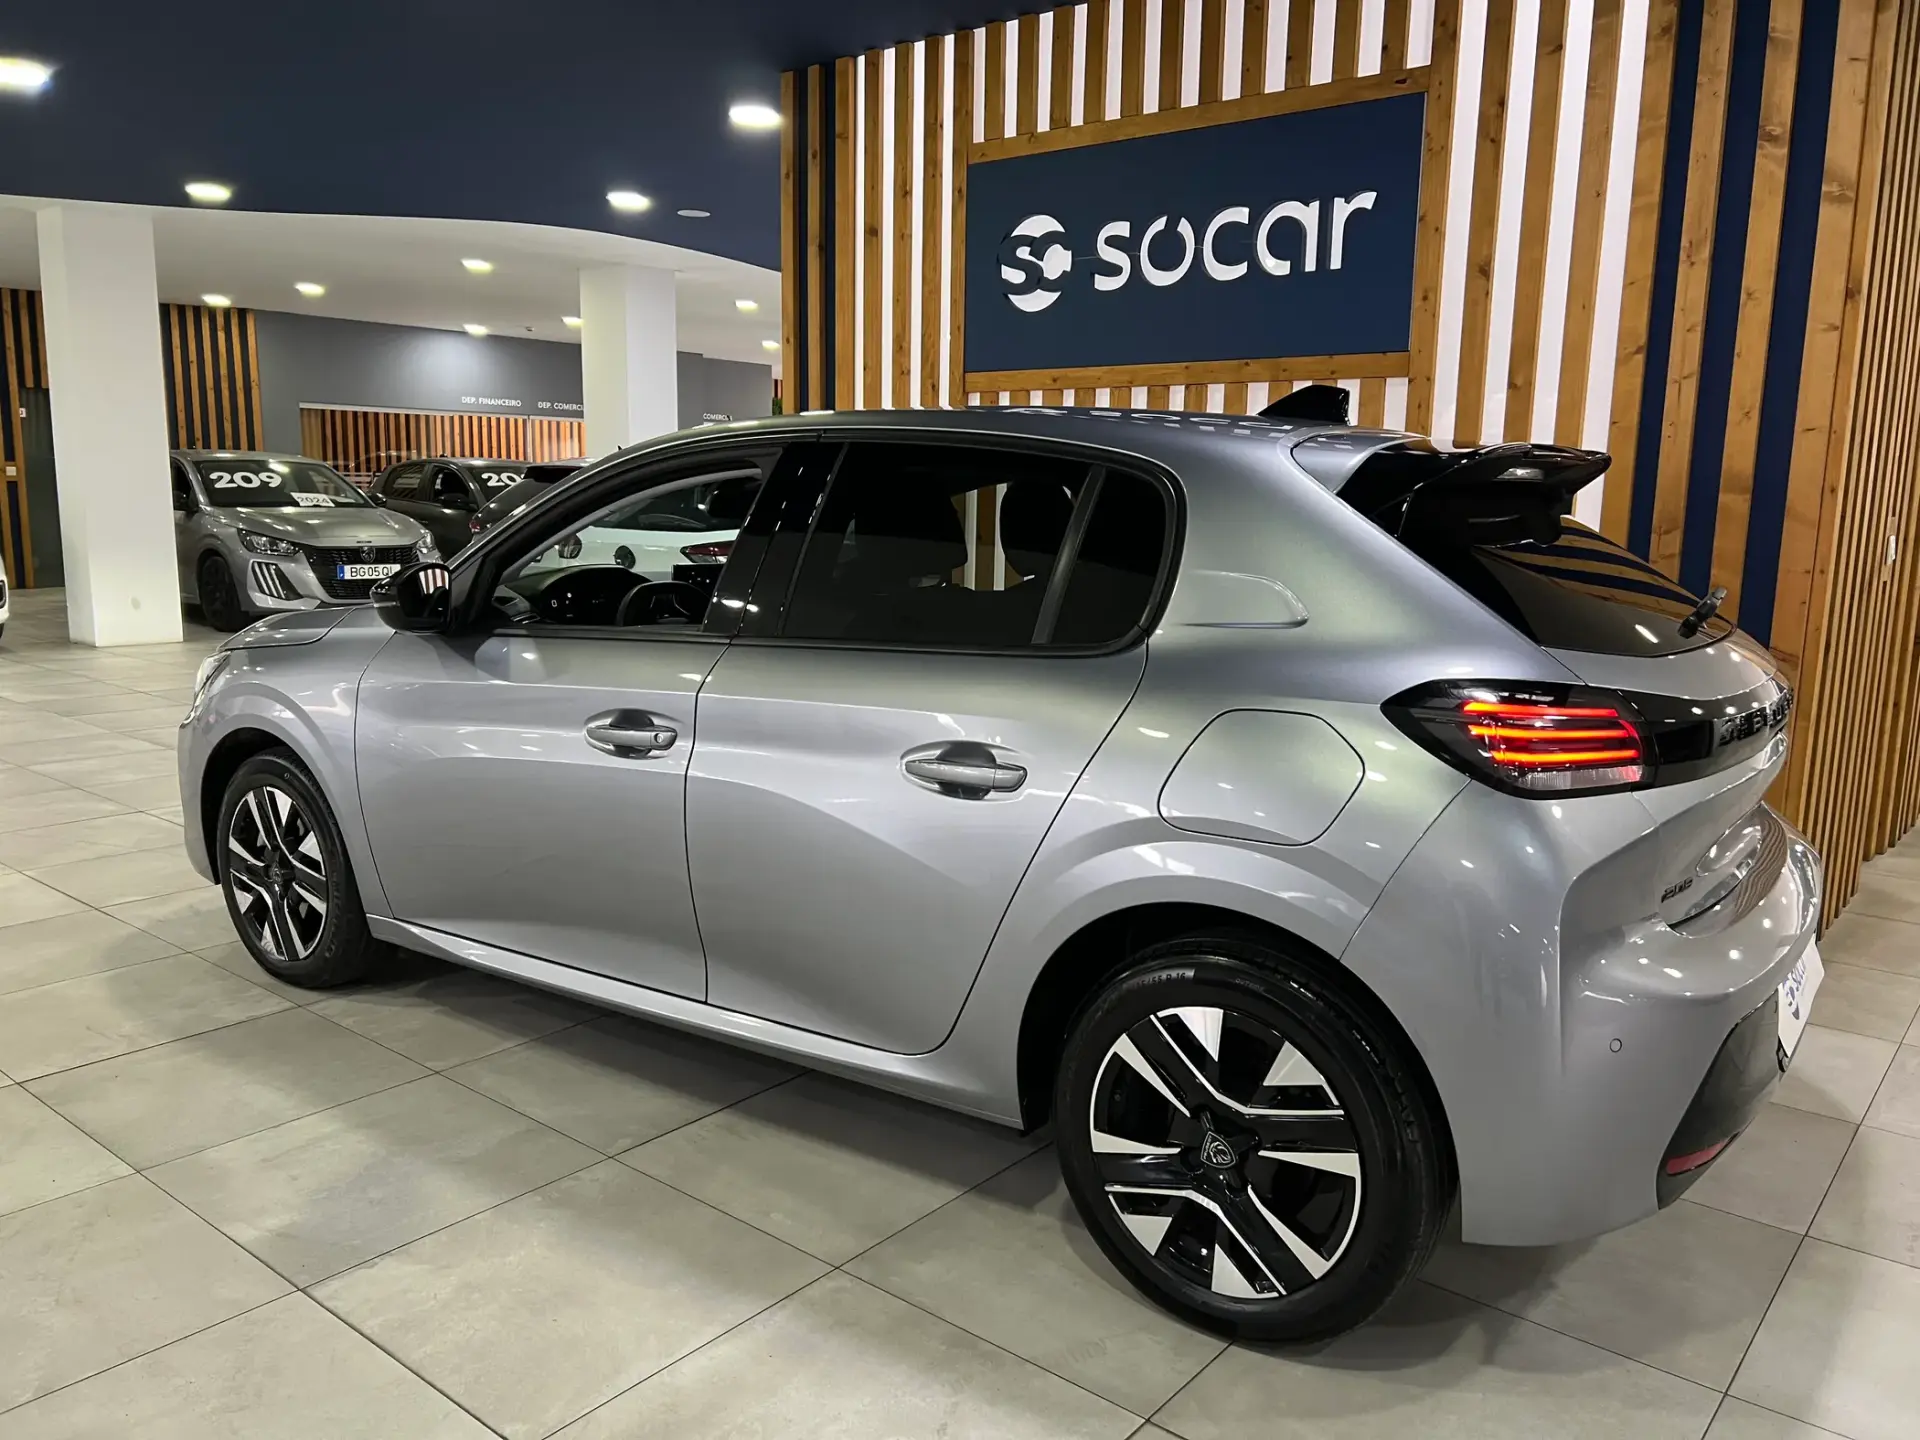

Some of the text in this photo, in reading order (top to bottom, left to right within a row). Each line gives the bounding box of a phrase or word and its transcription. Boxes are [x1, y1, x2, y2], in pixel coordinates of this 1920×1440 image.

[1094, 190, 1378, 292] socar
[461, 396, 522, 407] DEP. FINANCEIRO
[537, 401, 584, 411] DEP. COMERCI
[209, 471, 282, 488] 209
[481, 472, 525, 487] 20
